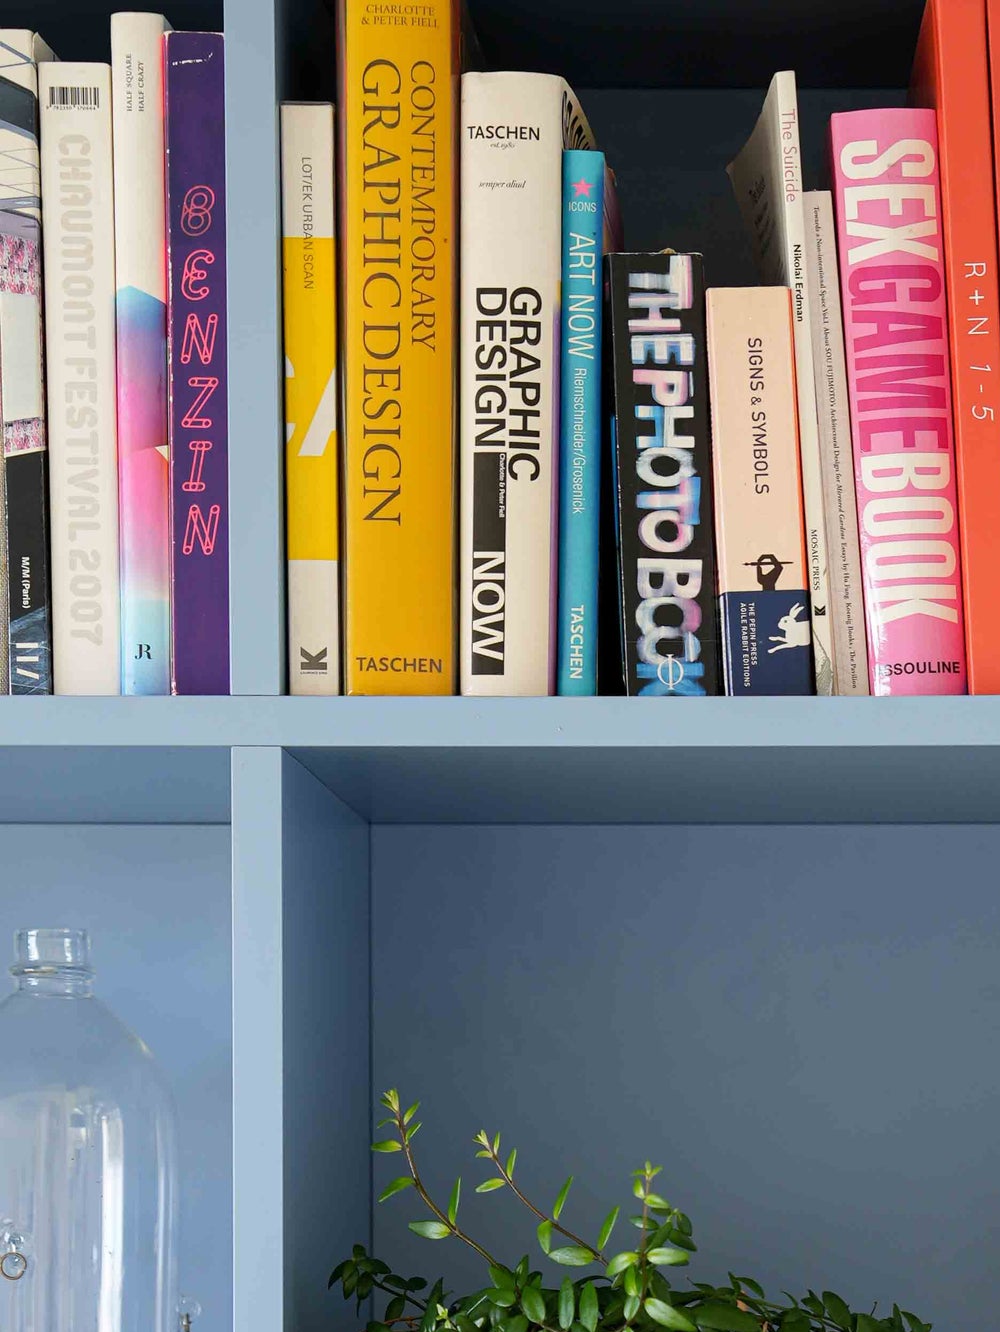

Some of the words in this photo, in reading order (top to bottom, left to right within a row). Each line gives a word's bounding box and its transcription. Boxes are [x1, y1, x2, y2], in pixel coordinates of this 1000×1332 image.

[361, 17, 370, 26] &
[373, 15, 408, 27] PETER
[411, 17, 439, 29] FIELL
[365, 3, 435, 17] CHARLOTTE
[467, 125, 540, 141] TASCHEN
[781, 108, 796, 141] The
[301, 157, 312, 202] LOT/EK
[362, 58, 402, 310] GRAPHIC
[783, 146, 797, 203] Suicide
[410, 60, 436, 354] CONTEMPORARY
[568, 201, 597, 213] ICONS
[303, 205, 313, 250] URBAN
[303, 254, 314, 290] SCAN
[568, 232, 596, 285] ART
[793, 244, 801, 281] Nikolai
[815, 239, 826, 289] Non-intentional
[628, 255, 696, 365] THE
[795, 283, 803, 323] Erdman
[819, 290, 827, 308] Space
[568, 294, 595, 360] NOW
[474, 286, 508, 448] DESIGN
[748, 336, 765, 391] SIGNS
[507, 286, 542, 482] GRAPHIC
[751, 396, 763, 406] &
[362, 320, 402, 526] DESIGN
[830, 408, 839, 450] Architectural
[571, 367, 587, 515] Riemschneider/Grosenick
[751, 411, 770, 495] SYMBOLS
[832, 450, 841, 472] Design
[836, 484, 845, 513] Mirrored
[810, 528, 819, 562] MOSAIC
[840, 542, 848, 562] Essays
[21, 556, 30, 579] M/M
[812, 565, 821, 592] PRESS
[841, 563, 849, 572] by
[843, 573, 850, 583] Hu
[21, 579, 31, 609] (Paris)
[69, 550, 103, 647] 2007
[472, 551, 505, 662] NOW
[843, 584, 851, 600] Fang
[845, 602, 854, 625] Koenig
[569, 605, 585, 680] TASCHEN
[741, 626, 749, 652] RABBIT
[356, 656, 443, 674] TASCHEN
[742, 654, 750, 688] EDITIONS
[850, 663, 858, 689] Pavilion
[879, 661, 961, 677] SSOULINE
